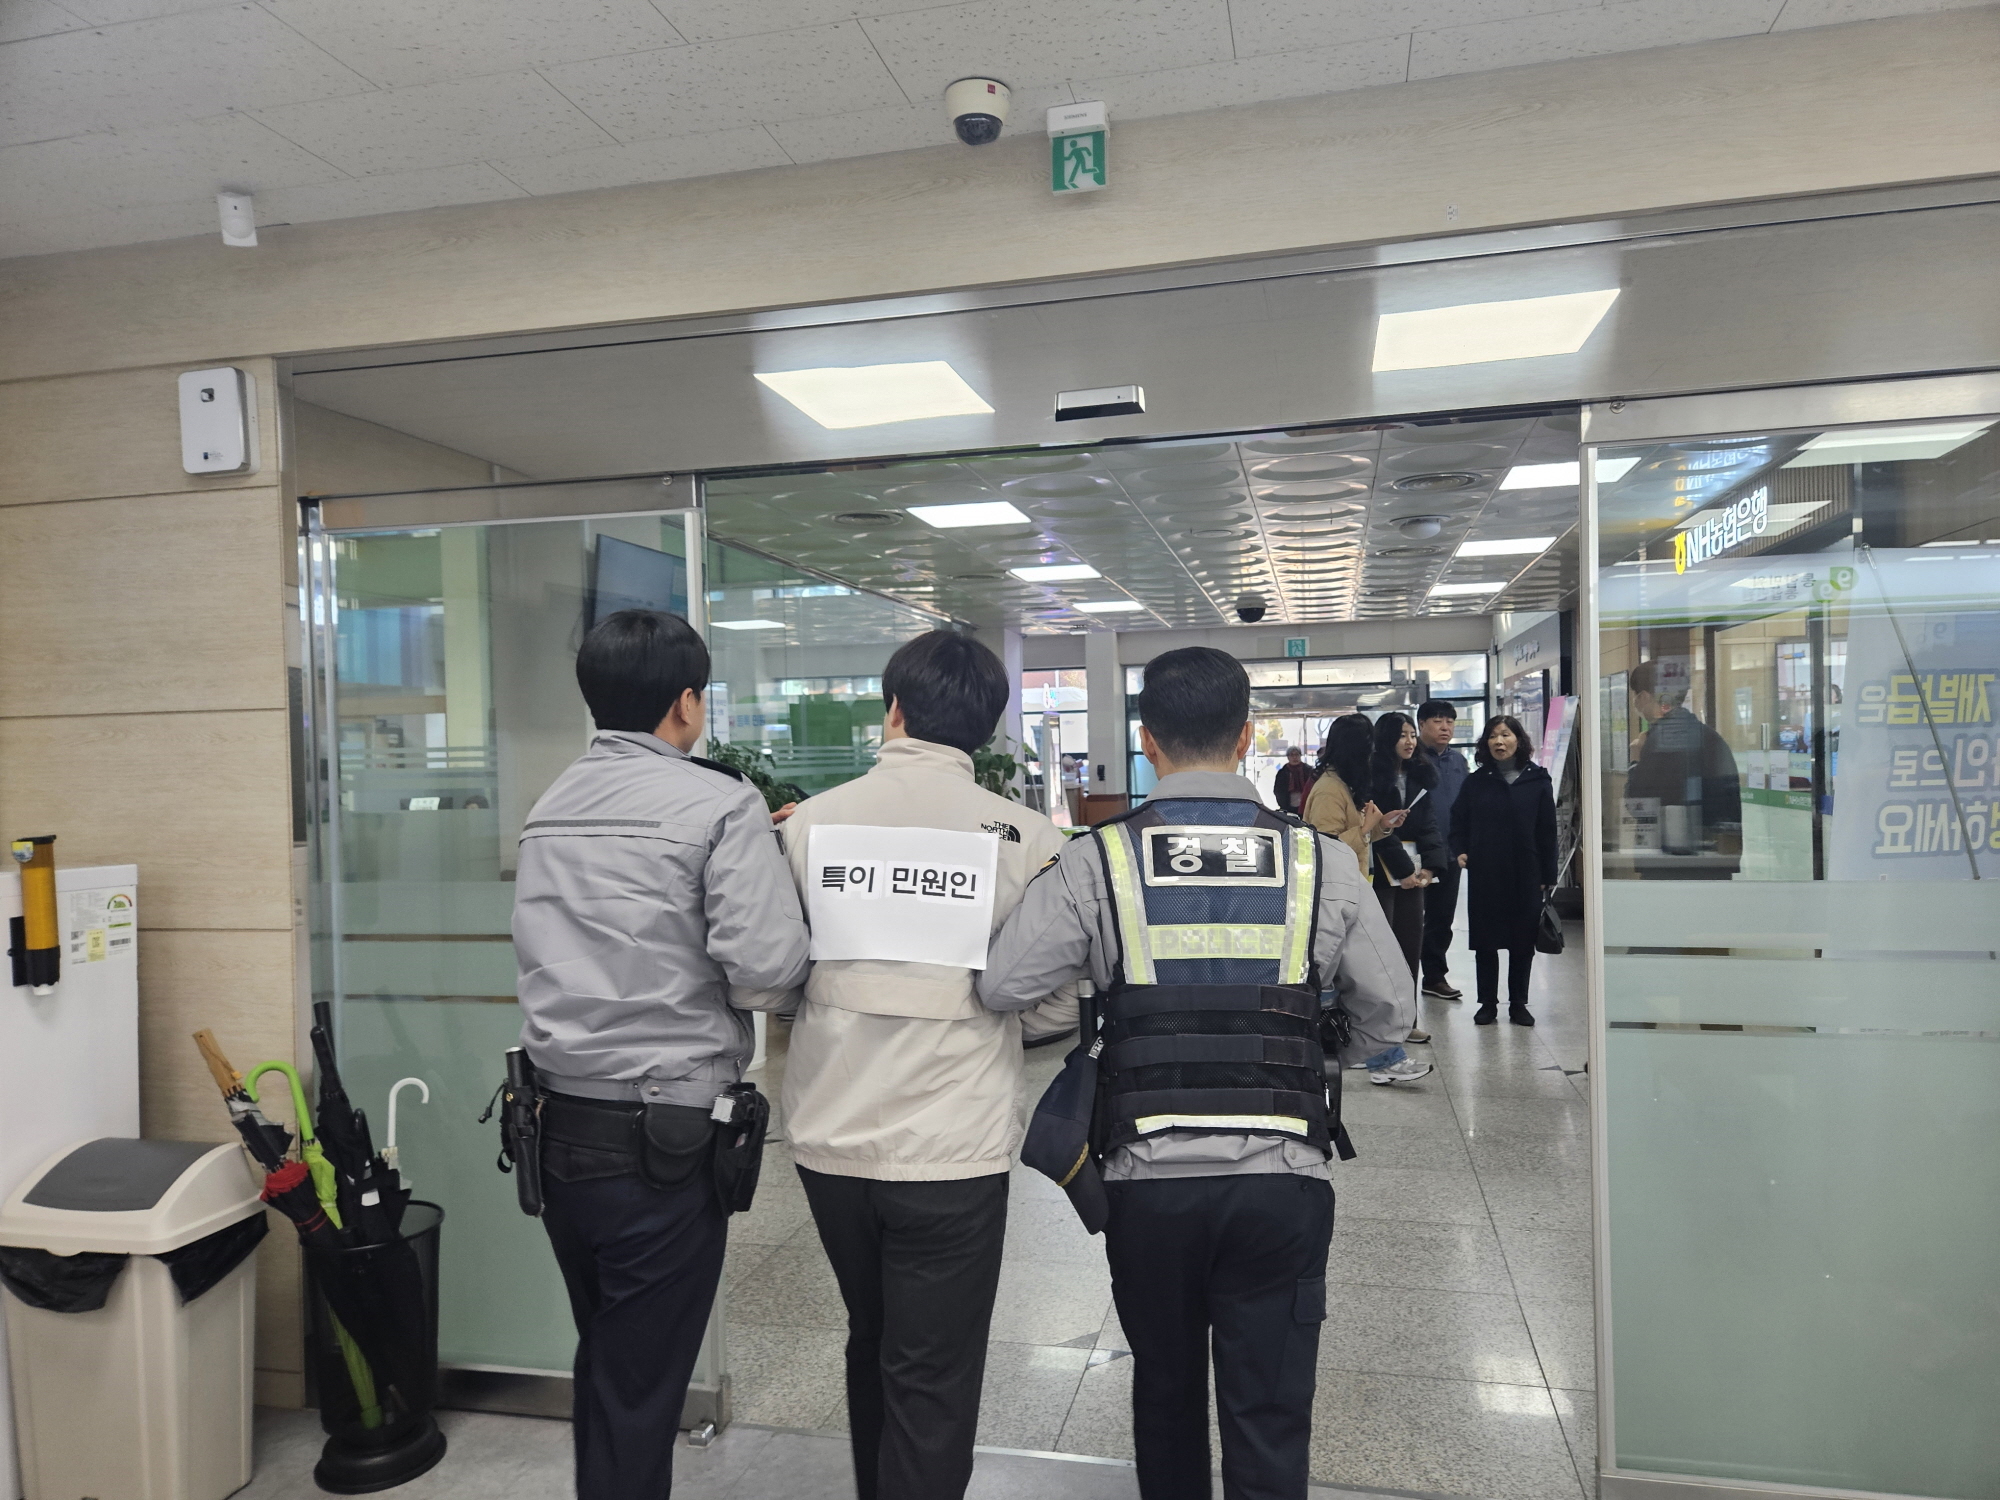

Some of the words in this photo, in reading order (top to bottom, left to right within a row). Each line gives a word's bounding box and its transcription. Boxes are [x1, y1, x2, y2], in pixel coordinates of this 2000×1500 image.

[1686, 485, 1768, 567] NH농협은행
[981, 823, 1008, 835] NORTH
[994, 820, 1009, 829] THE
[1167, 836, 1259, 873] 경찰
[821, 865, 876, 893] 특이
[892, 867, 977, 900] 민원인
[1158, 927, 1277, 955] POLICE
